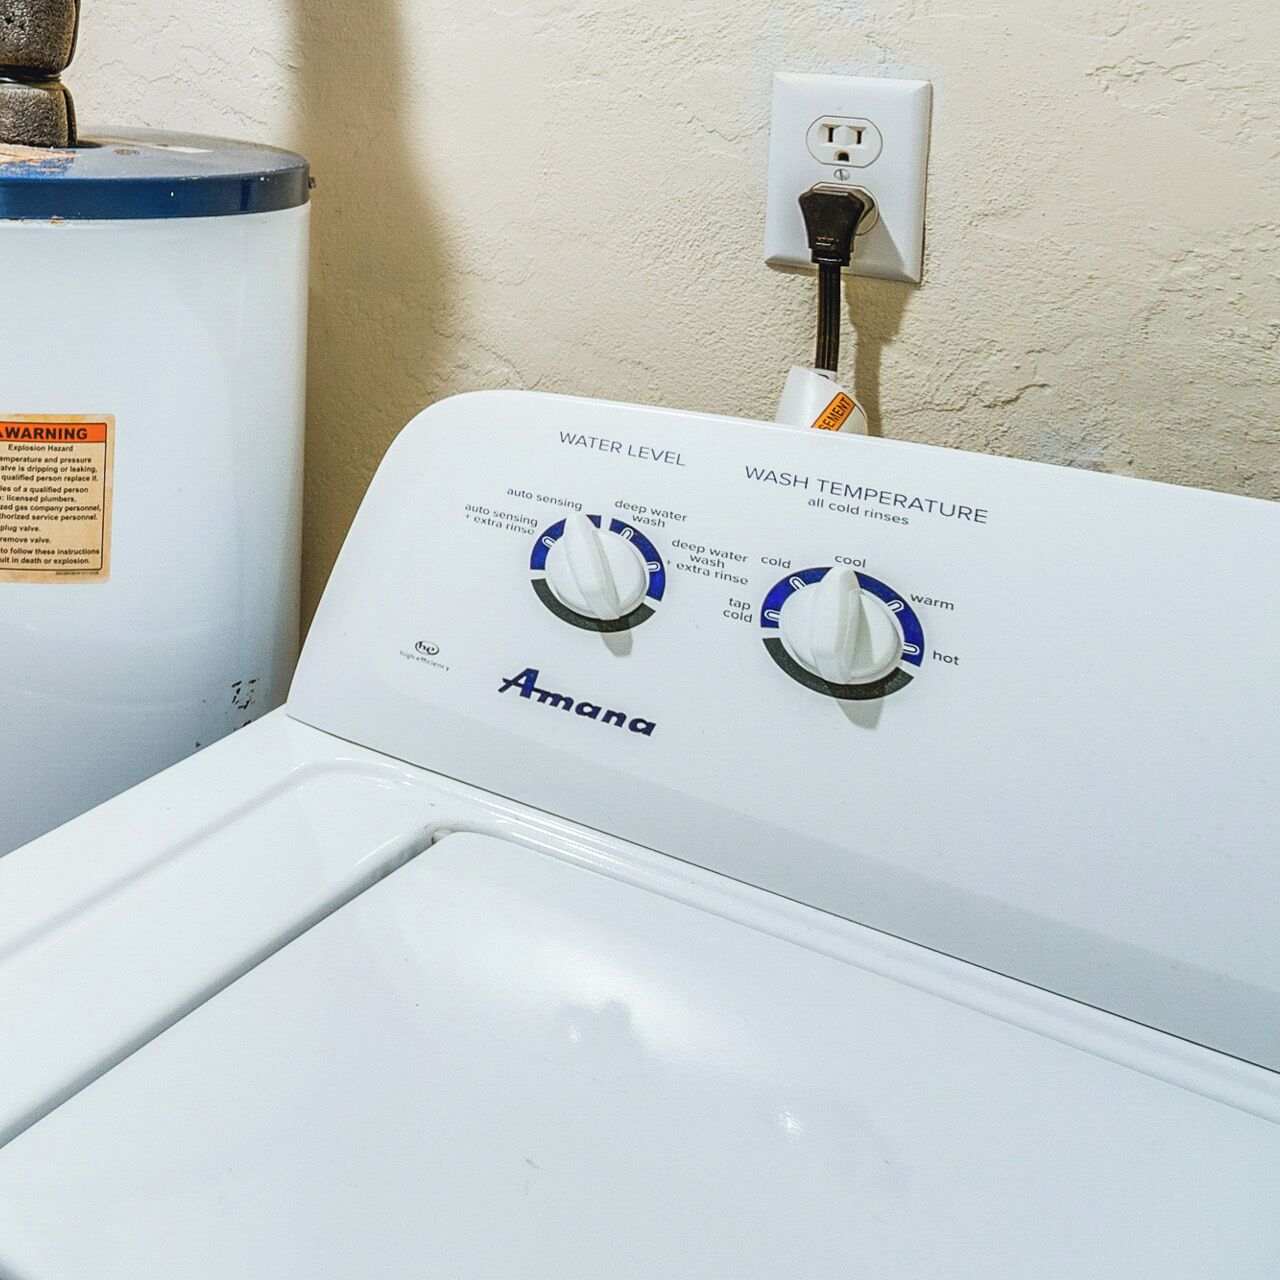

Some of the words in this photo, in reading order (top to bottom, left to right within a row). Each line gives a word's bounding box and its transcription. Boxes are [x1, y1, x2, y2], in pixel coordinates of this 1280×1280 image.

[4, 426, 89, 440] WARNING
[7, 443, 46, 453] Explosion
[46, 444, 74, 452] Hazard
[558, 430, 623, 454] WATER
[626, 444, 687, 467] LEVEL
[26, 464, 59, 474] dripping
[59, 457, 93, 465] pressure
[0, 473, 35, 482] qualified
[35, 475, 62, 483] person
[506, 487, 533, 501] auto
[536, 493, 584, 512] sensing
[744, 465, 810, 490] WASH
[816, 478, 990, 525] TEMPERATURE
[464, 502, 491, 516] auto
[492, 509, 539, 528] sensing
[614, 498, 648, 515] deep
[650, 508, 689, 523] water
[807, 496, 825, 509] all
[828, 501, 860, 516] cold
[863, 507, 910, 526] rinses
[0, 524, 18, 533] plug
[473, 514, 503, 529] extra
[505, 522, 536, 536] rinse
[631, 513, 667, 529] wash
[0, 546, 9, 554] to
[10, 546, 34, 555] follow
[34, 547, 56, 555] these
[56, 547, 100, 555] instructions
[671, 538, 706, 555] deep
[708, 547, 749, 564] water
[689, 554, 726, 570] wash
[760, 554, 792, 570] cold
[834, 552, 867, 569] cool
[676, 561, 712, 578] extra
[714, 569, 750, 586] rinse
[728, 597, 752, 613] tap
[909, 592, 956, 612] warm
[722, 608, 754, 624] cold
[932, 650, 961, 667] hot
[497, 667, 658, 739] Amana
